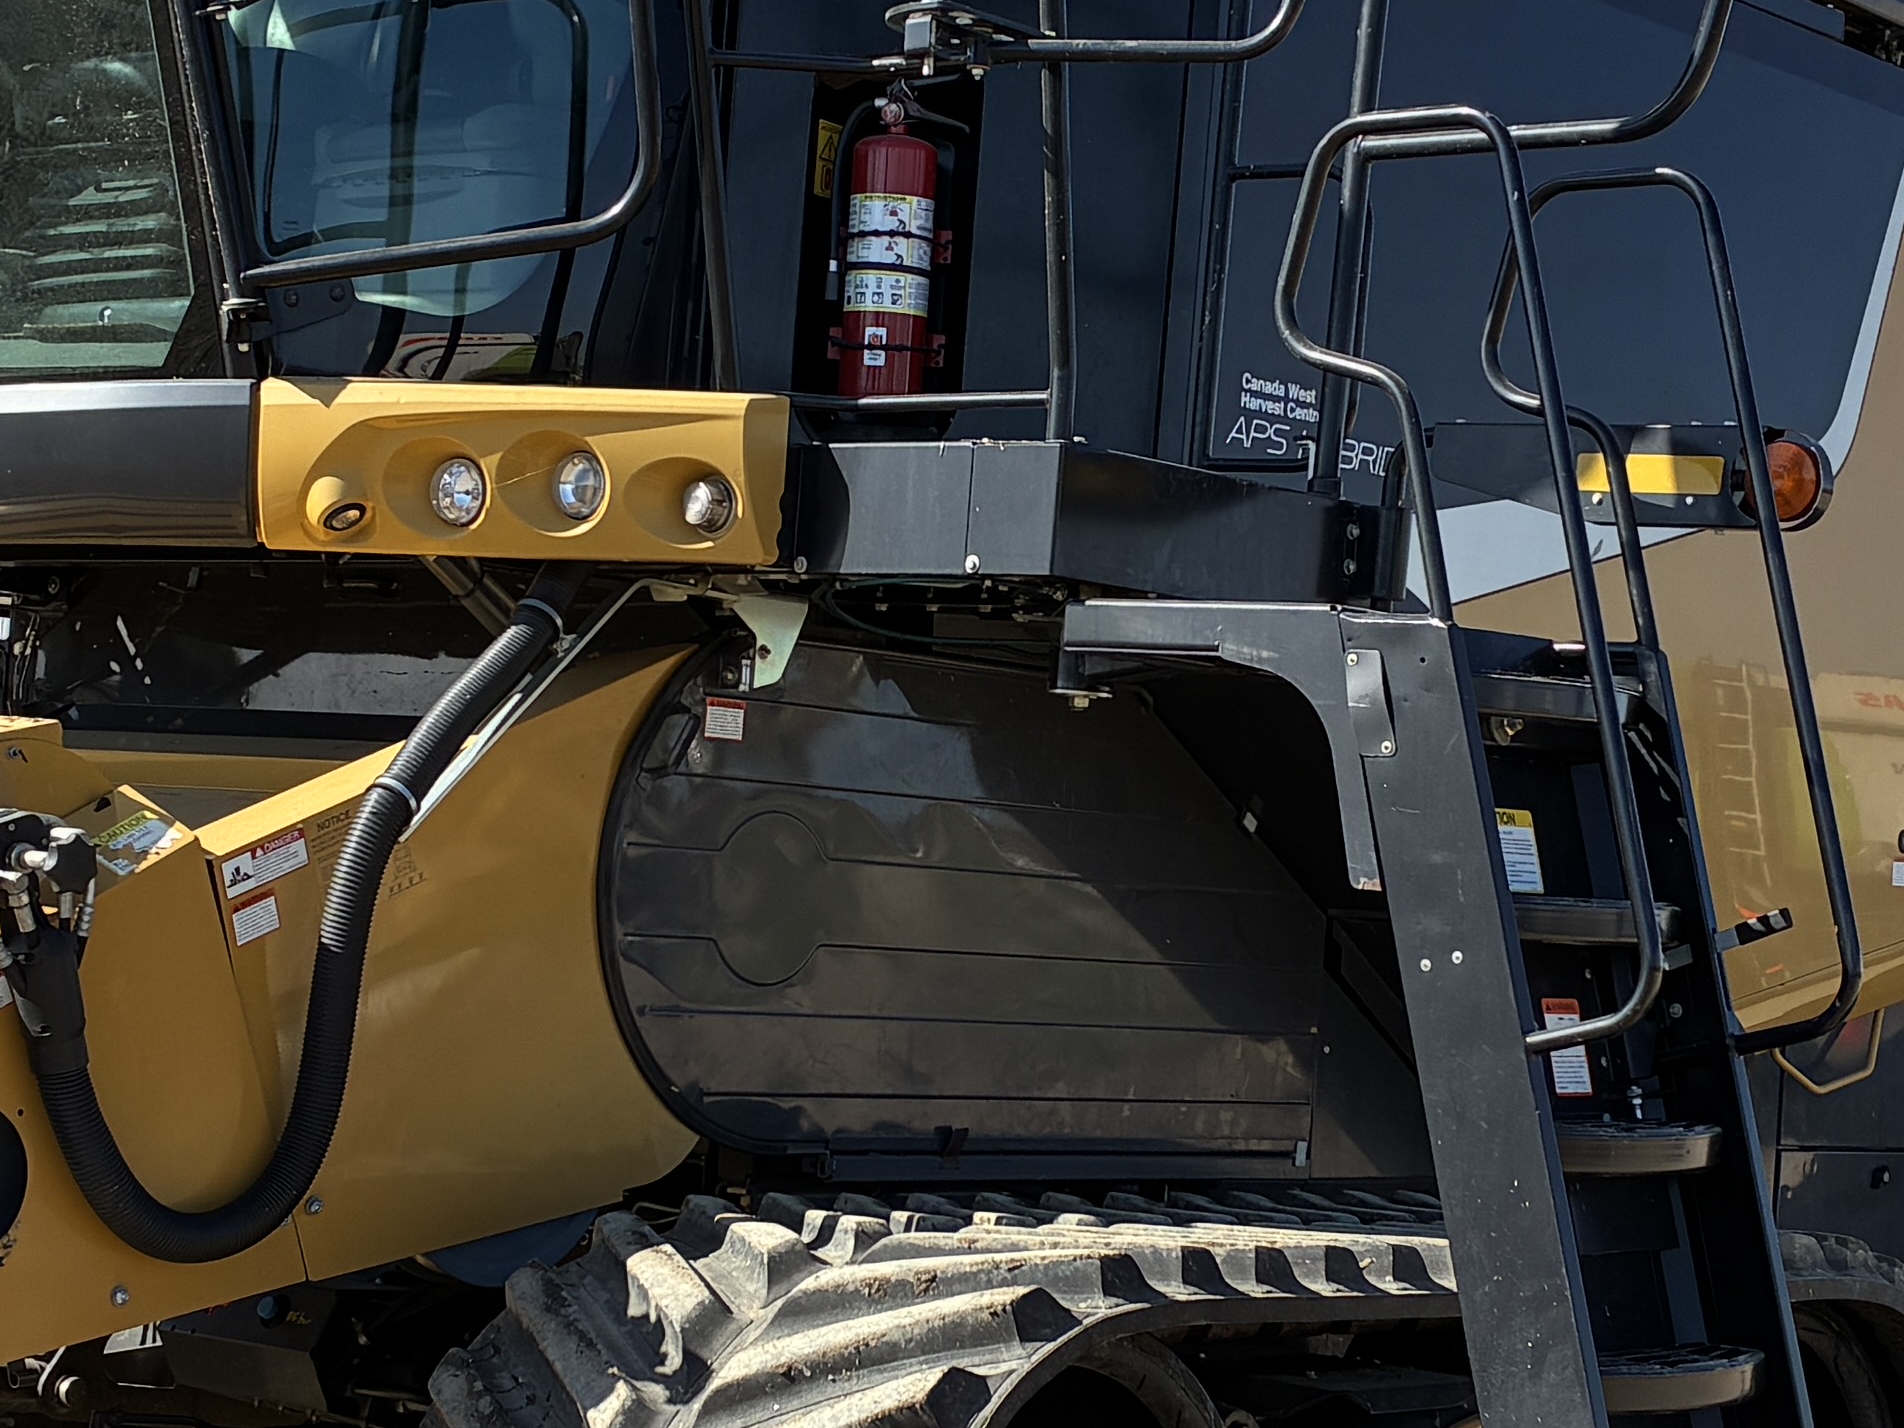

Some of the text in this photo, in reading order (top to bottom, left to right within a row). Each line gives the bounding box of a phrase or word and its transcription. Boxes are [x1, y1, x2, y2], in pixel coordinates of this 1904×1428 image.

[1240, 391, 1285, 416] Harvest
[1242, 373, 1316, 405] Canada West
[1226, 416, 1291, 455] APS
[98, 812, 148, 844] CAUTION
[264, 831, 300, 853] DANGER
